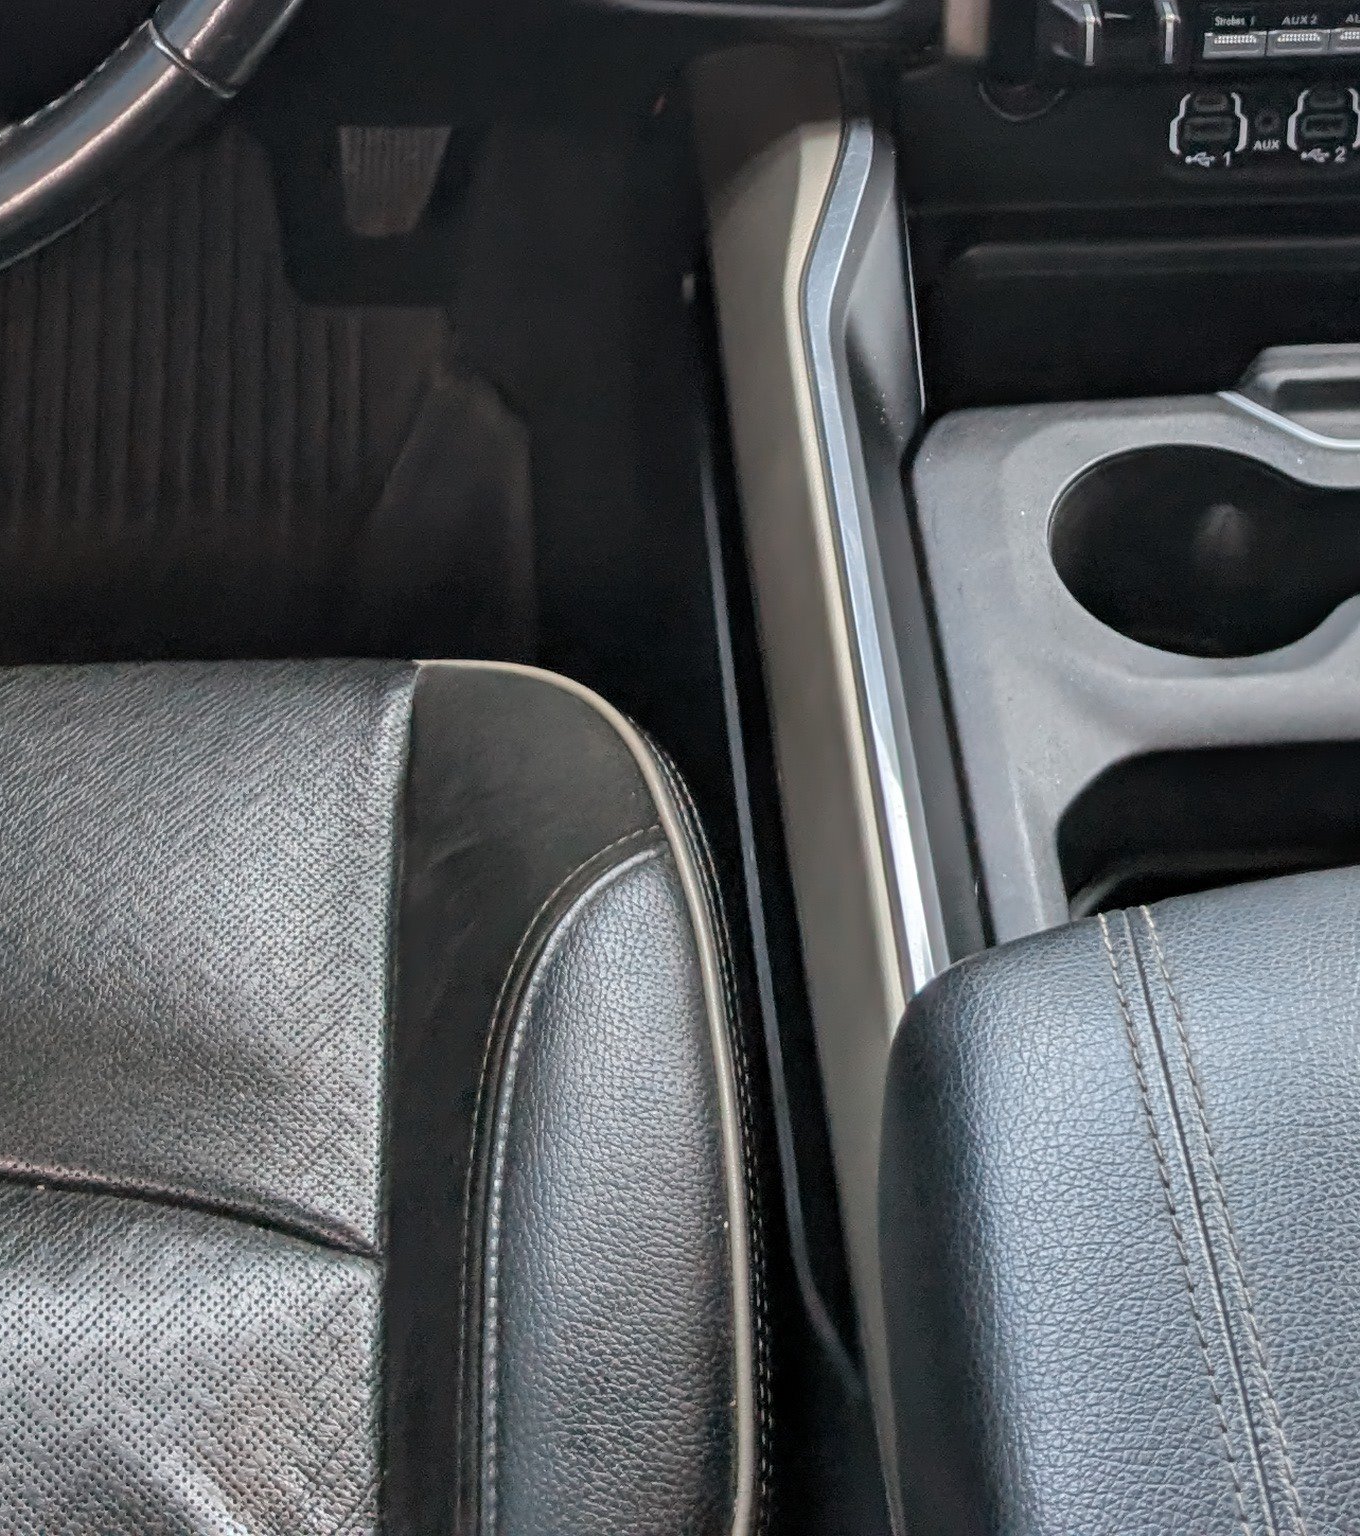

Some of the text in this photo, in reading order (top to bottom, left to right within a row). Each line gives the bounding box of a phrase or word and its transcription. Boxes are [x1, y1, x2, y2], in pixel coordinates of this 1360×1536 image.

[1215, 16, 1245, 27] Strobes
[1282, 16, 1308, 25] AUX
[1253, 139, 1280, 152] AUX
[1222, 152, 1232, 167] 1
[1334, 147, 1347, 162] 2
